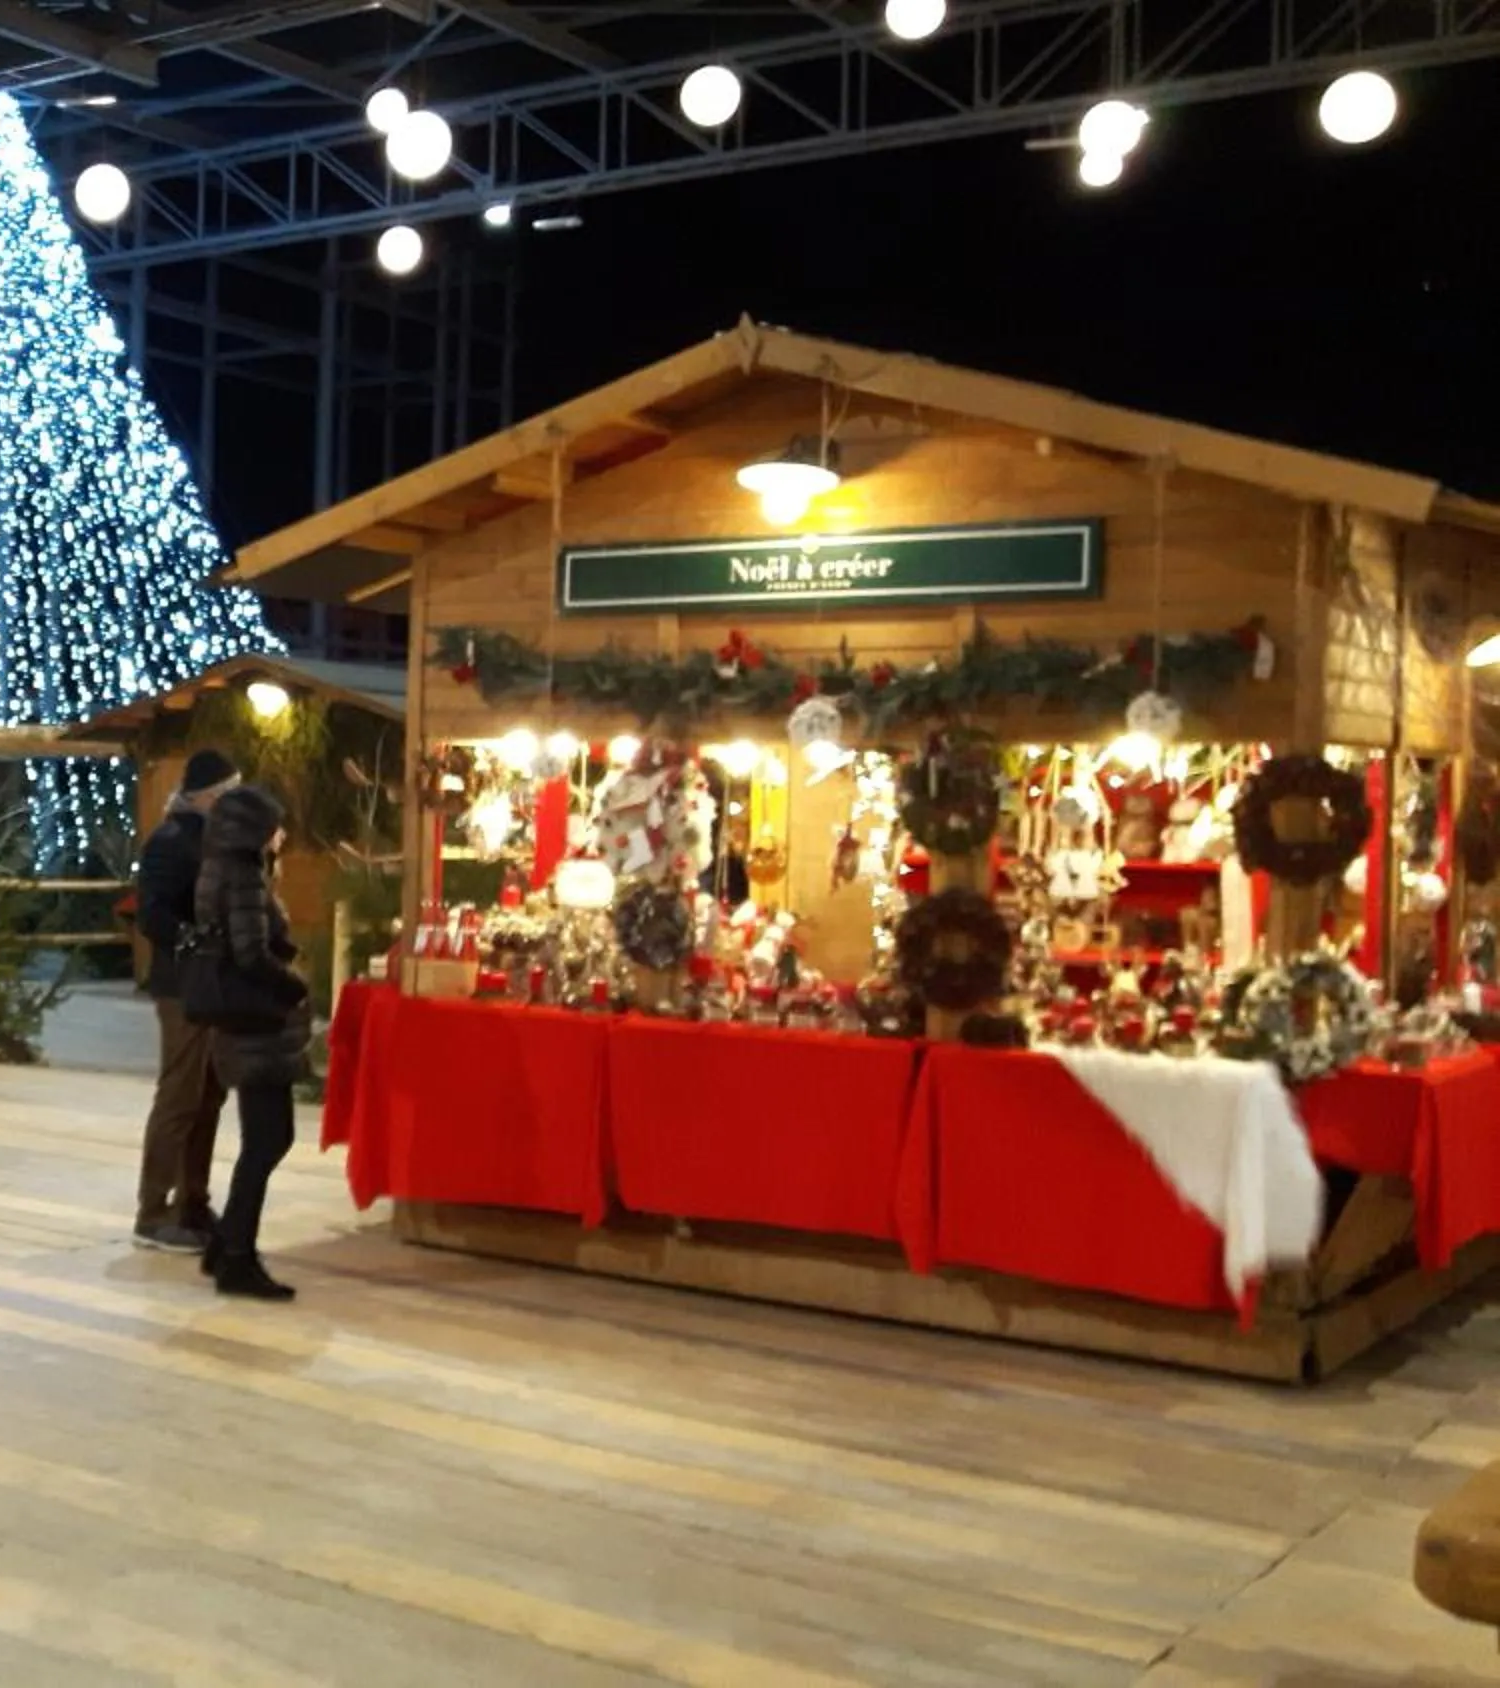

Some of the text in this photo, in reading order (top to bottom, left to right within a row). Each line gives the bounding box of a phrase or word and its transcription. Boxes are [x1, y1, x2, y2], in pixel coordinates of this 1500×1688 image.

[729, 552, 893, 584] Noël à créer
